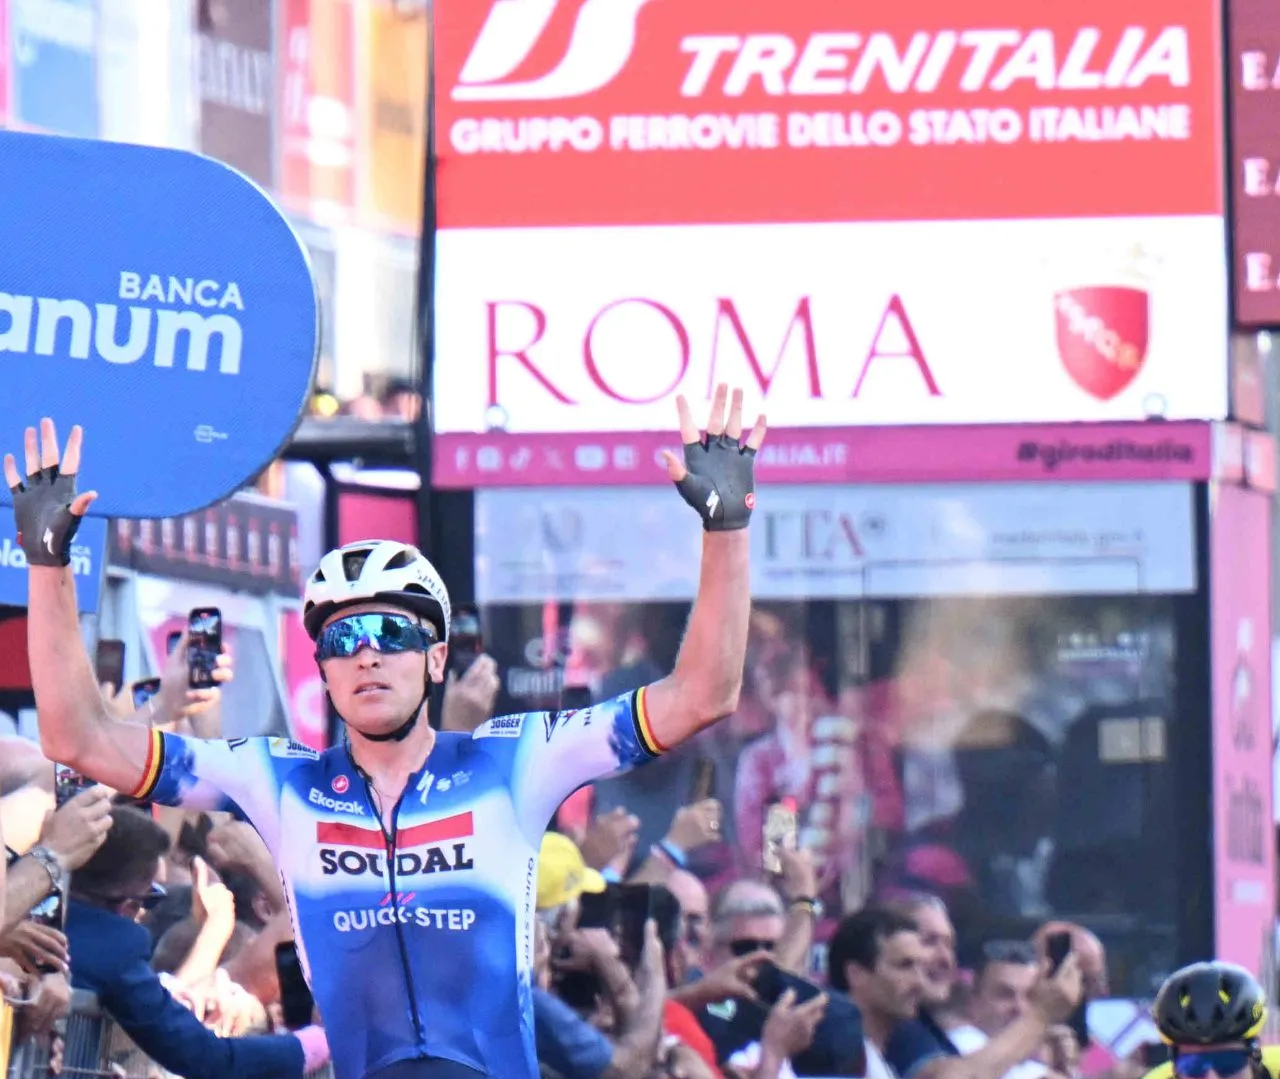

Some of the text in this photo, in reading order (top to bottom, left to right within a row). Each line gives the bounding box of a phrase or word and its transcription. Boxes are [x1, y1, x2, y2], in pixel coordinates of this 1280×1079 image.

[679, 25, 1191, 97] TRENITALIA
[451, 104, 1190, 154] GRUPPO FERROVIE DELLO STATO ITALIANE
[118, 271, 245, 311] BANCA
[484, 293, 944, 404] ROMA
[308, 786, 365, 816] Ekopak
[320, 843, 473, 878] SOUDAL
[333, 906, 476, 932] QUICK-STEP
